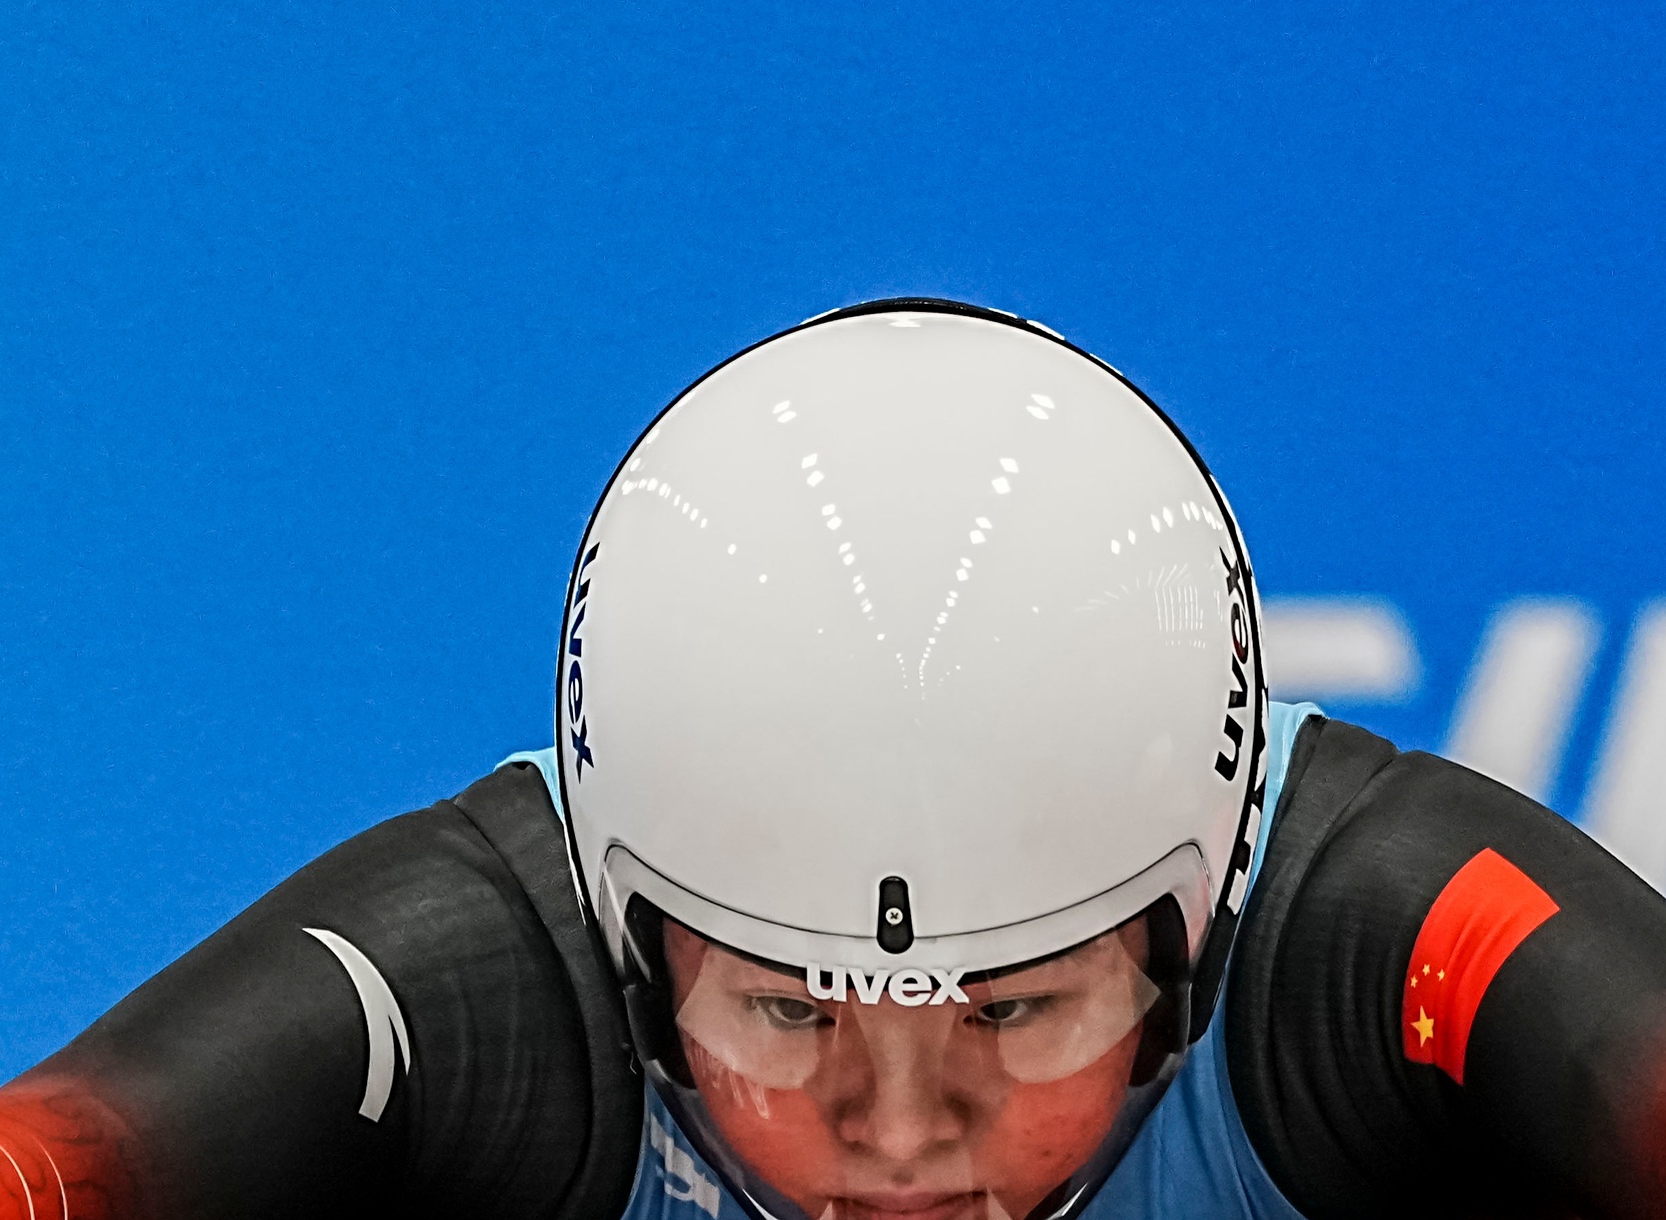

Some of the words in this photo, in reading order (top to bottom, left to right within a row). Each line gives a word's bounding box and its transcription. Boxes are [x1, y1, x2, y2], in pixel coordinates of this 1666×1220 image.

[568, 542, 600, 784] uvex
[1215, 546, 1249, 782] uvex
[806, 960, 970, 1007] uvex
